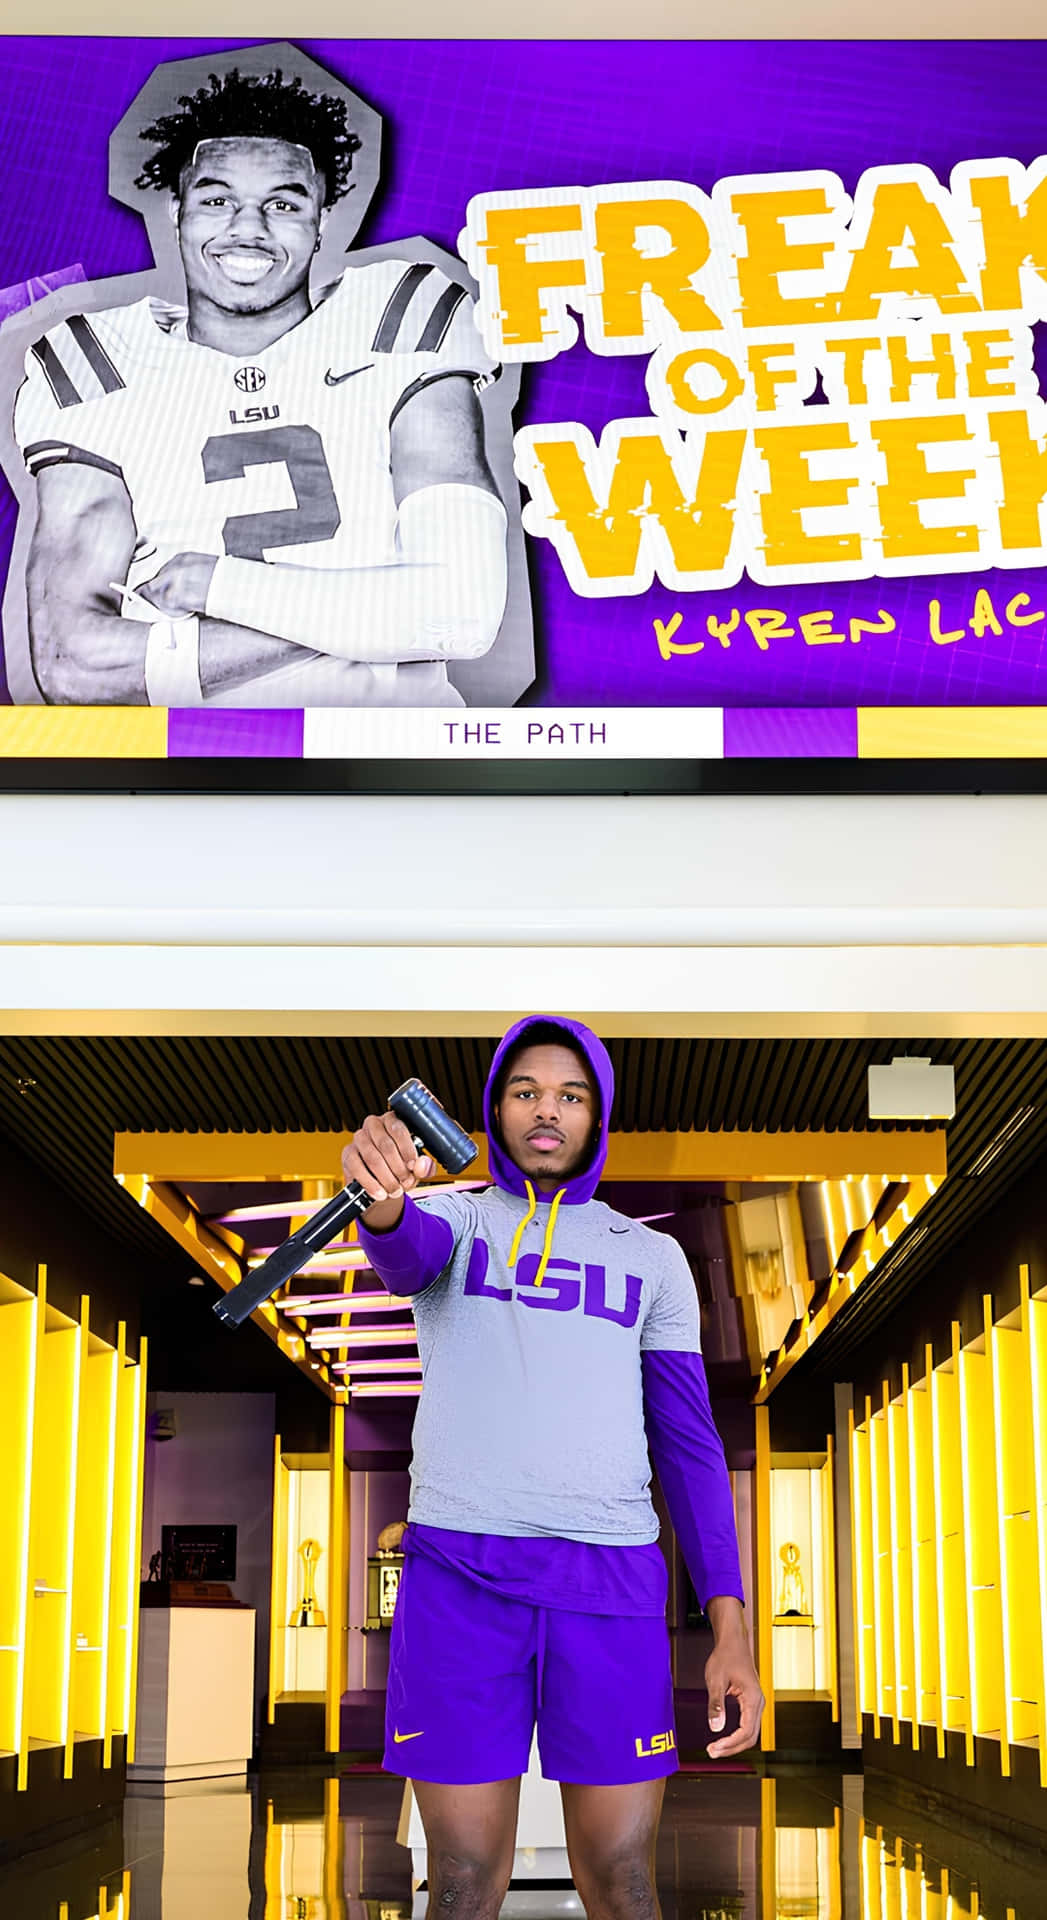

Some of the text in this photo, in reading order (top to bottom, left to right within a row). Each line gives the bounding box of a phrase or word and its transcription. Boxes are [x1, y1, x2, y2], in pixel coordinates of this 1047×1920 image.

[478, 176, 1047, 345] FREAK
[234, 367, 266, 392] SEC
[666, 329, 1016, 414] OF THE
[229, 405, 279, 424] LSU
[201, 425, 341, 565] 2
[653, 608, 896, 660] KYREN
[443, 723, 606, 744] THE PATH
[464, 1237, 643, 1328] LSU
[635, 1729, 676, 1757] LSU
